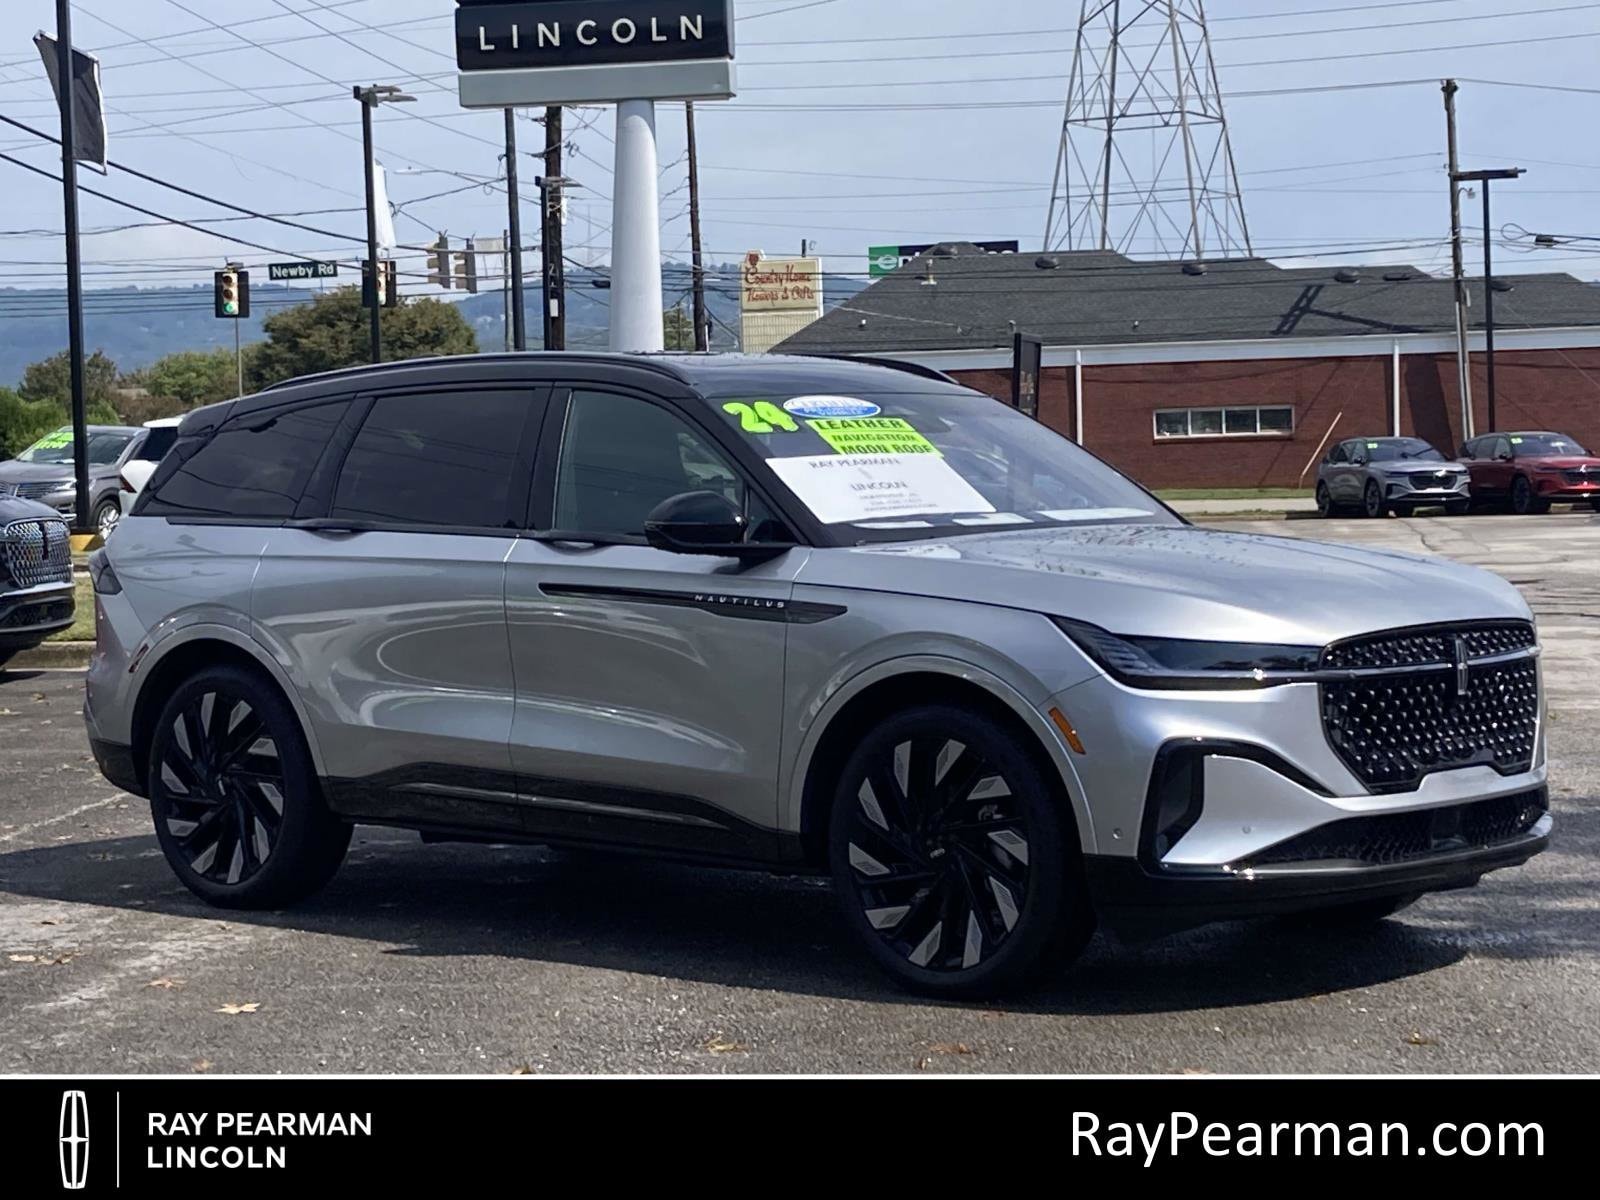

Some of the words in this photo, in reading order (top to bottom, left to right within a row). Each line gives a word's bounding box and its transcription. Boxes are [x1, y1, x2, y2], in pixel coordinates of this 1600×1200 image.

[479, 14, 703, 51] LINCOLN
[272, 264, 313, 279] Newby
[318, 263, 335, 275] Rd
[745, 265, 783, 286] Country
[784, 263, 812, 283] Home
[722, 401, 799, 433] 24
[814, 419, 905, 430] LEATHER
[831, 433, 920, 443] NAVIGATION
[840, 444, 890, 455] MOON
[892, 443, 934, 454] ROOF
[809, 459, 836, 470] RAY
[694, 595, 785, 608] NAUTILUS
